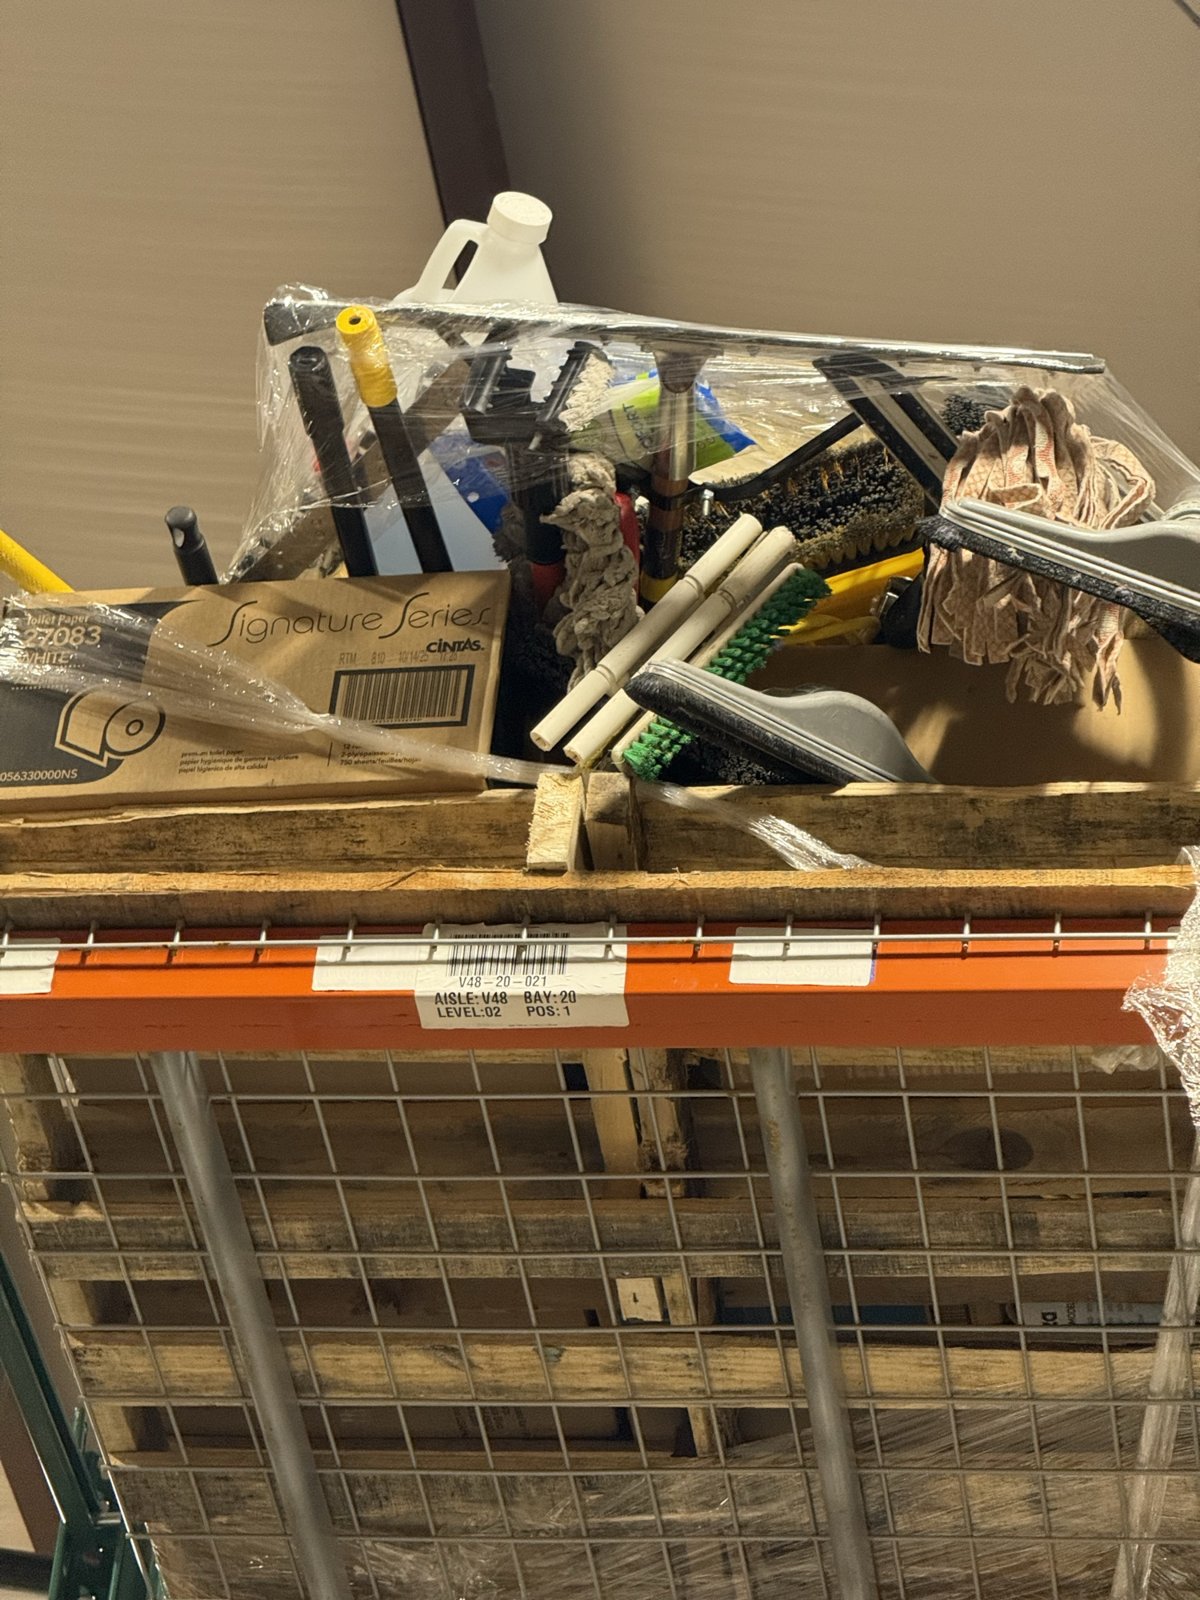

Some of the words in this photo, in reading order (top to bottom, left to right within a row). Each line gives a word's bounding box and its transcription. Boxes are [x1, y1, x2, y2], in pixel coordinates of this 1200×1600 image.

[26, 615, 55, 626] Toilet
[58, 614, 90, 626] Paper
[207, 601, 383, 647] Signature
[378, 592, 490, 639] Series
[23, 625, 102, 646] 27083
[19, 651, 70, 664] WHITE
